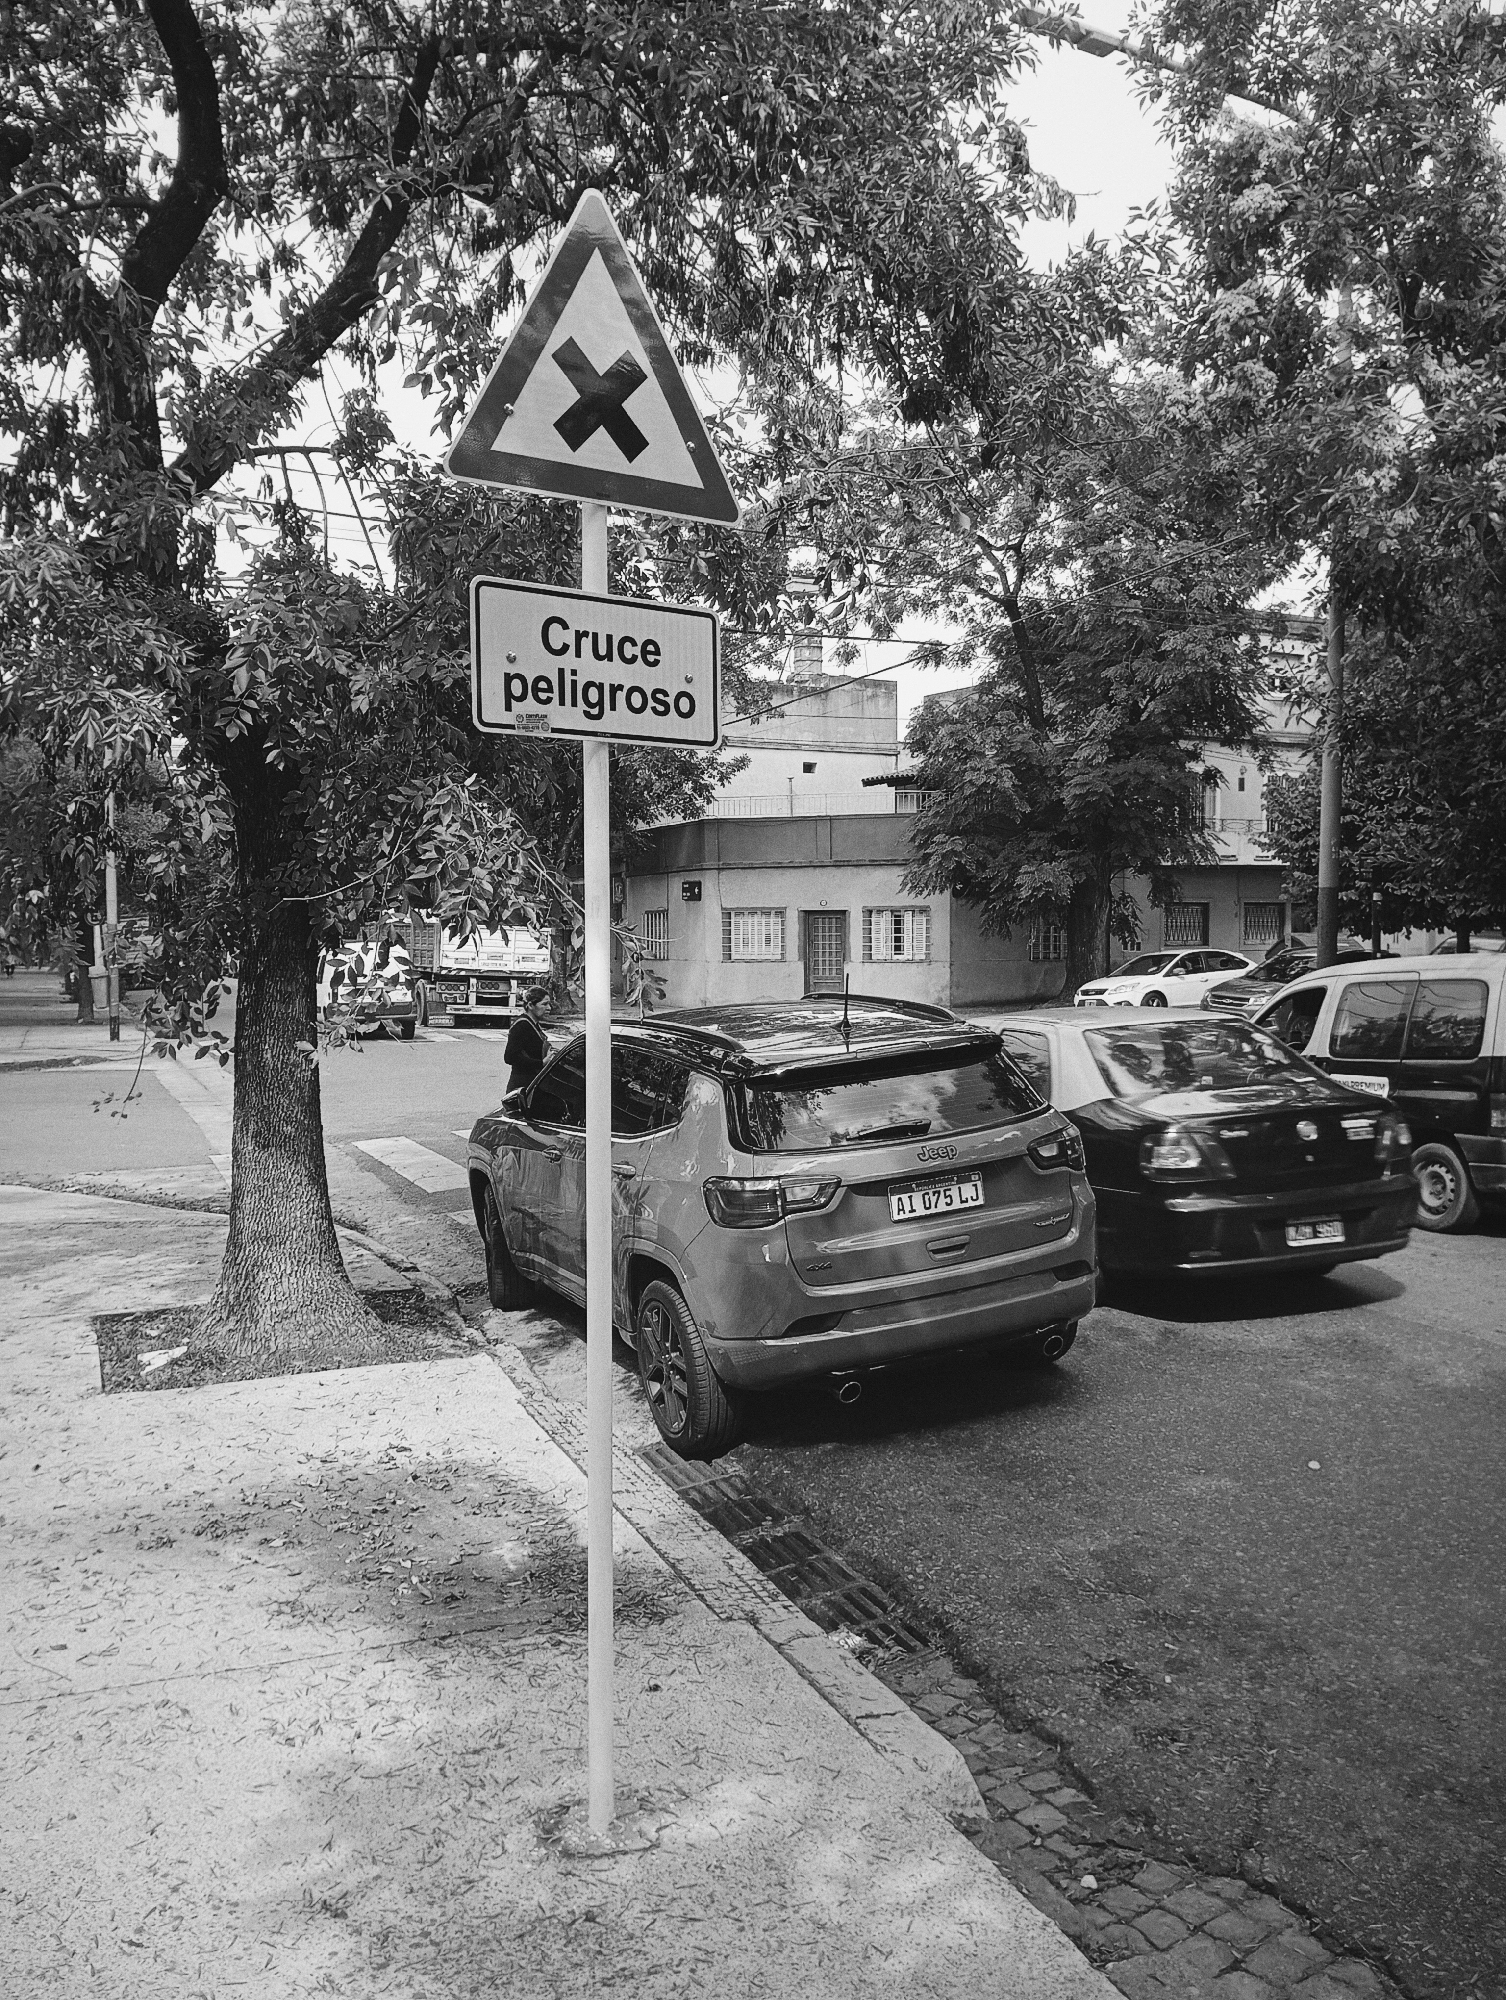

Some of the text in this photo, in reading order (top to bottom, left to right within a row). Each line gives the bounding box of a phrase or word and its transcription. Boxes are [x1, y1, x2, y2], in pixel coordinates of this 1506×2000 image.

[541, 615, 661, 667] Cruce
[504, 667, 696, 720] peligroso
[917, 1144, 958, 1162] Jeep
[897, 1183, 979, 1215] AI 075 LJ
